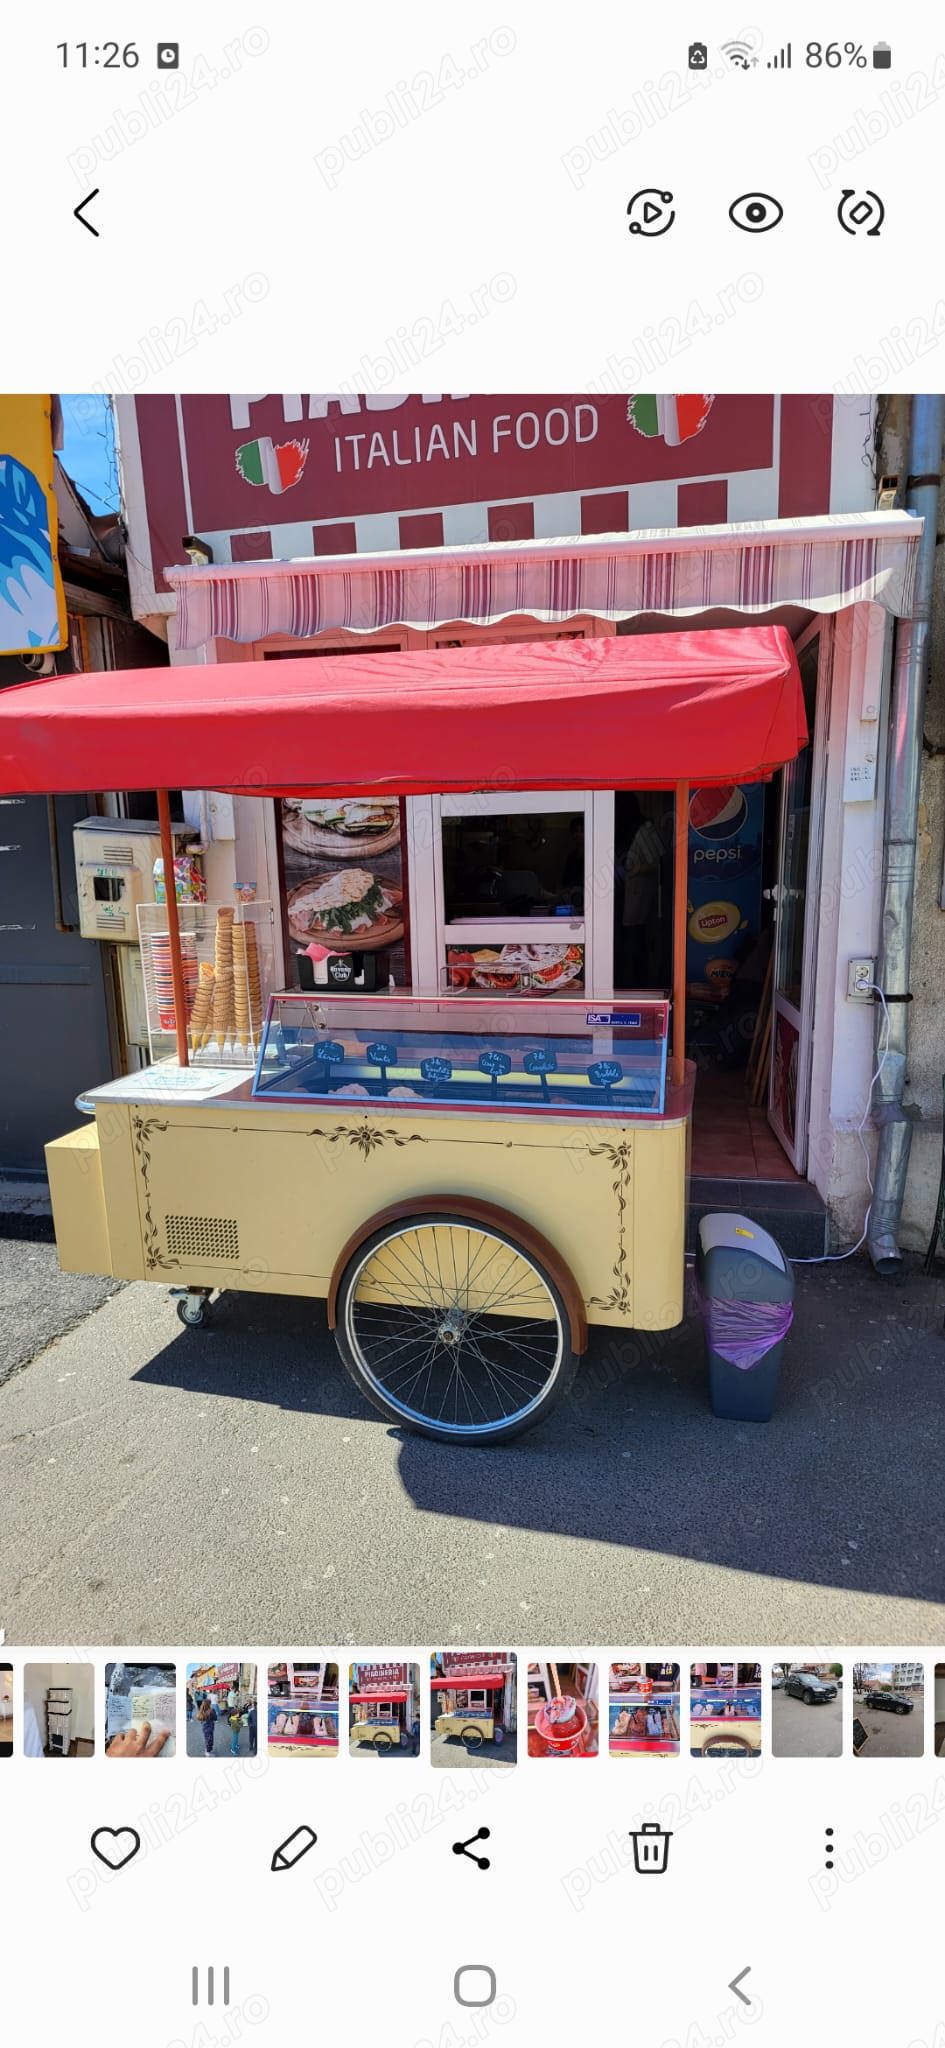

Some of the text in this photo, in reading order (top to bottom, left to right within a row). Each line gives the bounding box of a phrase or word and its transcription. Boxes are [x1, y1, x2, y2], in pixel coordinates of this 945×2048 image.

[57, 42, 139, 68] 11:26
[805, 42, 867, 68] 86%
[334, 419, 478, 472] ITALIAN
[492, 403, 600, 454] FOOD
[694, 845, 742, 863] pepsi
[701, 915, 726, 928] Lipton
[588, 1014, 601, 1022] ISA
